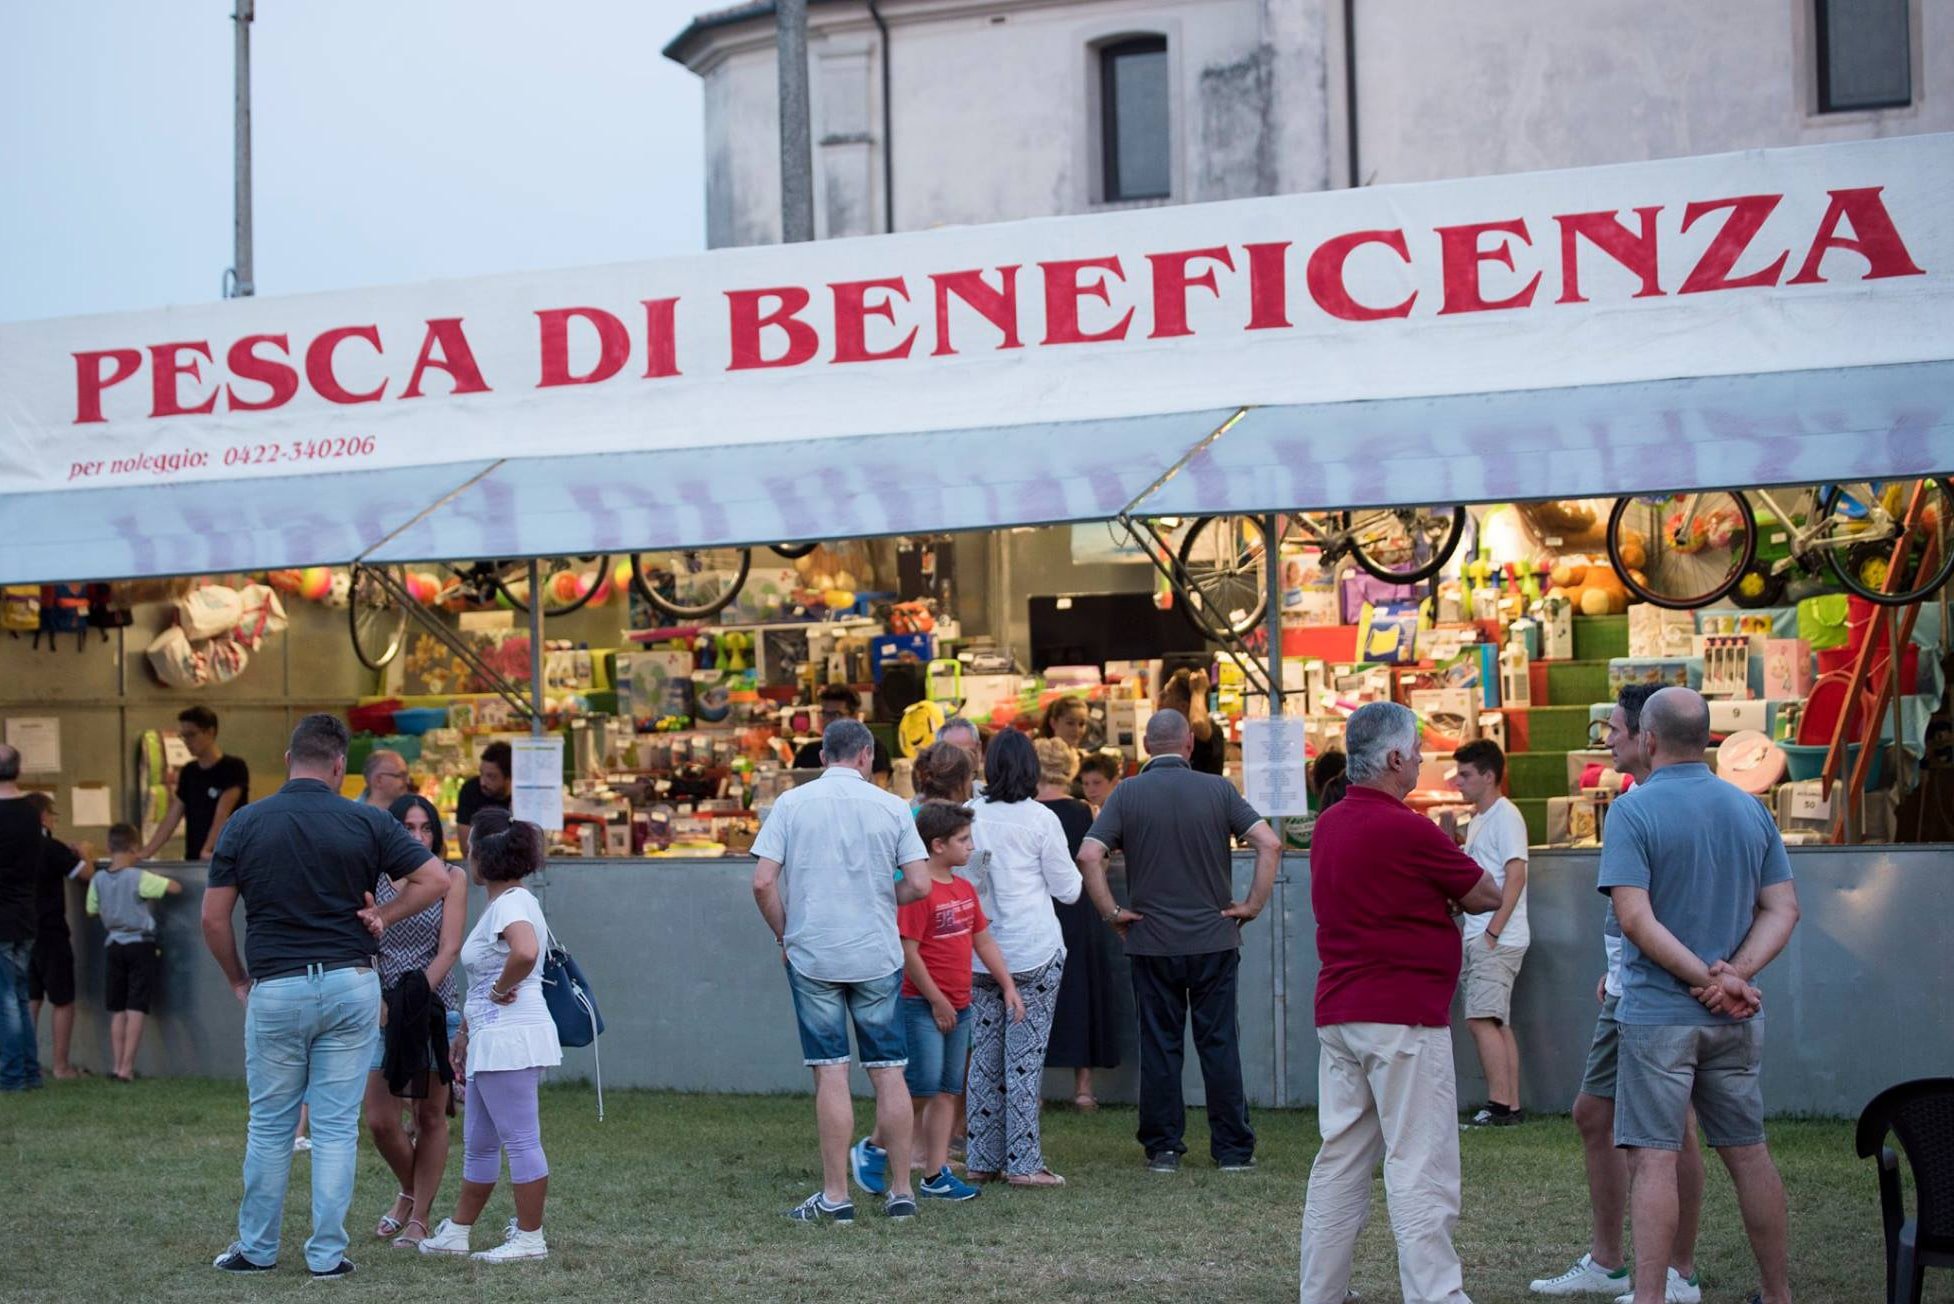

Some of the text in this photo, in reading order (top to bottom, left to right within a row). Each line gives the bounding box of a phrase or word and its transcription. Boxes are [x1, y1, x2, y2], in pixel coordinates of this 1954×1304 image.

[71, 186, 1926, 425] PESCA DI BENEFICENZA
[68, 435, 376, 481] per noleggio: 0422-340206
